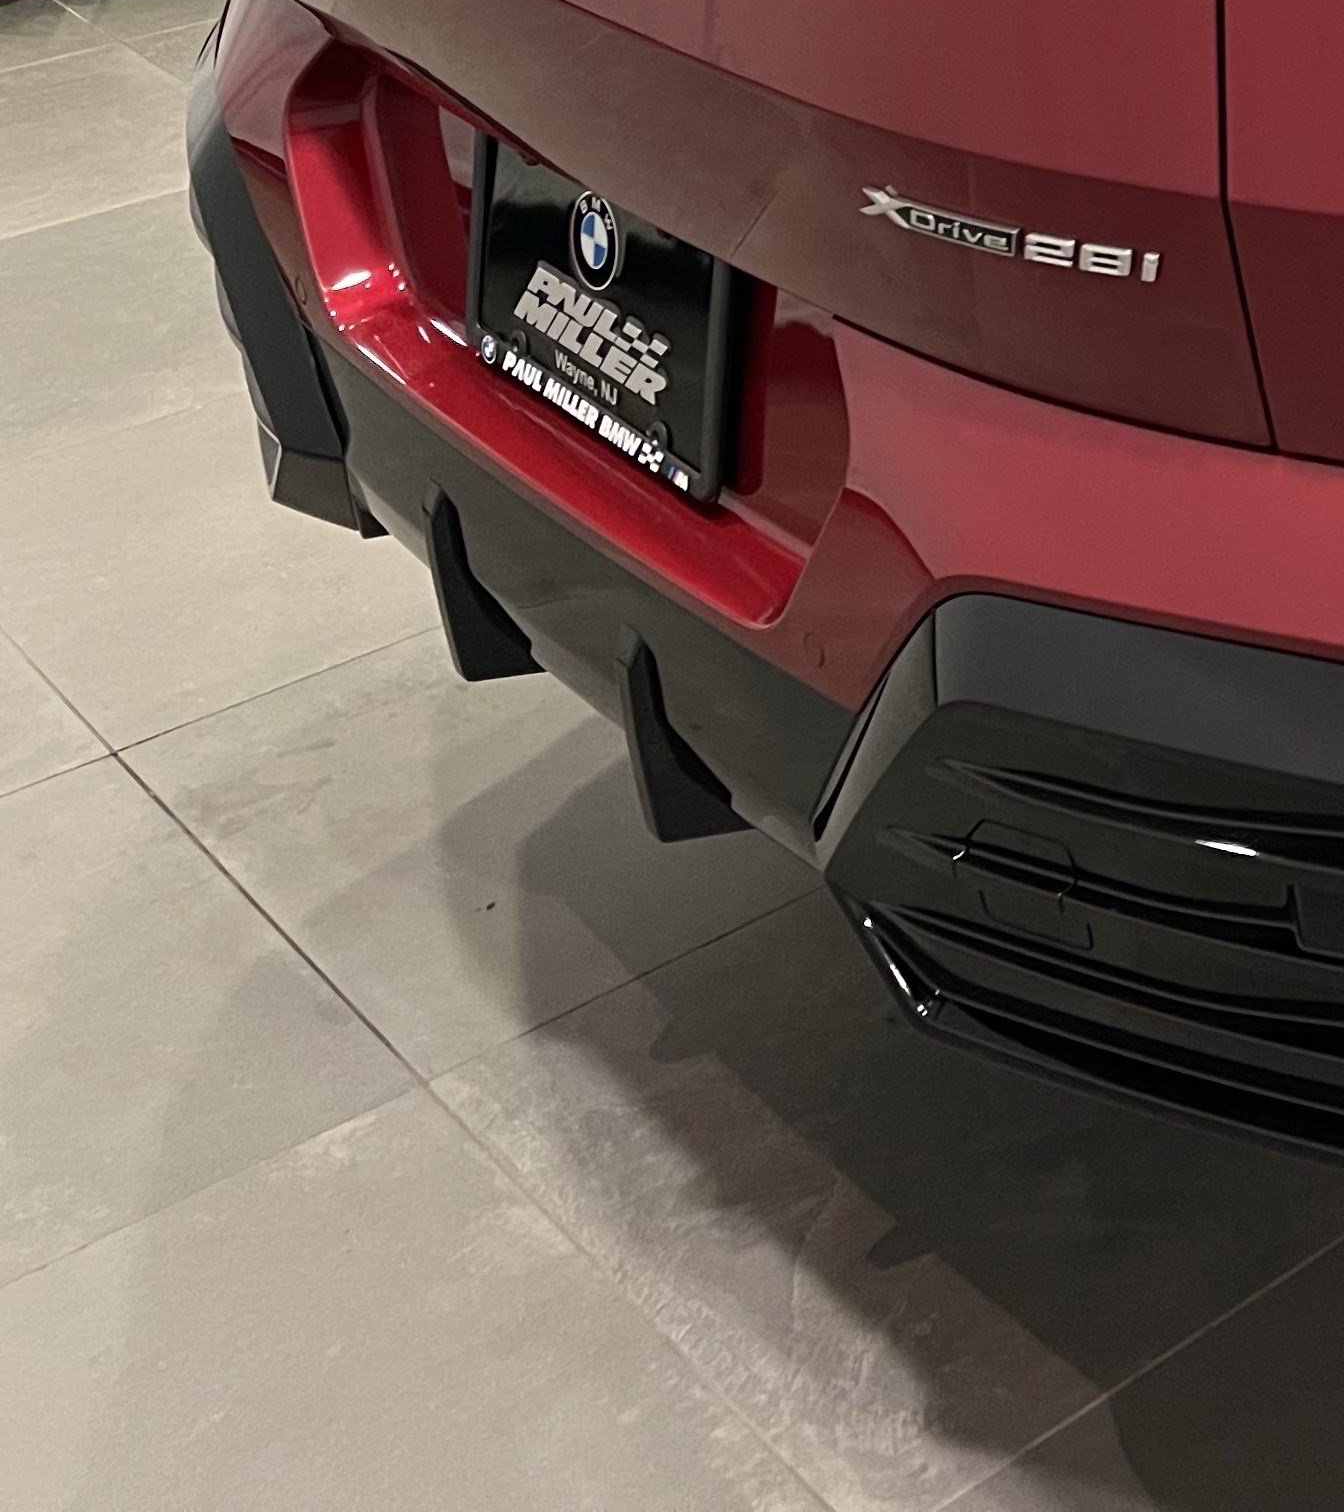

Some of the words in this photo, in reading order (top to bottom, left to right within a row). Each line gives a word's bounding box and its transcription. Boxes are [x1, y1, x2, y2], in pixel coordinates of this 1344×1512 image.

[579, 196, 614, 231] BMW
[527, 267, 617, 342] PAUL
[513, 290, 667, 405] MILLER
[554, 349, 598, 397] Wayne,
[601, 380, 618, 406] NJ
[502, 350, 543, 392] PAUL
[543, 377, 600, 429] MILLER
[598, 414, 642, 457] BMW
